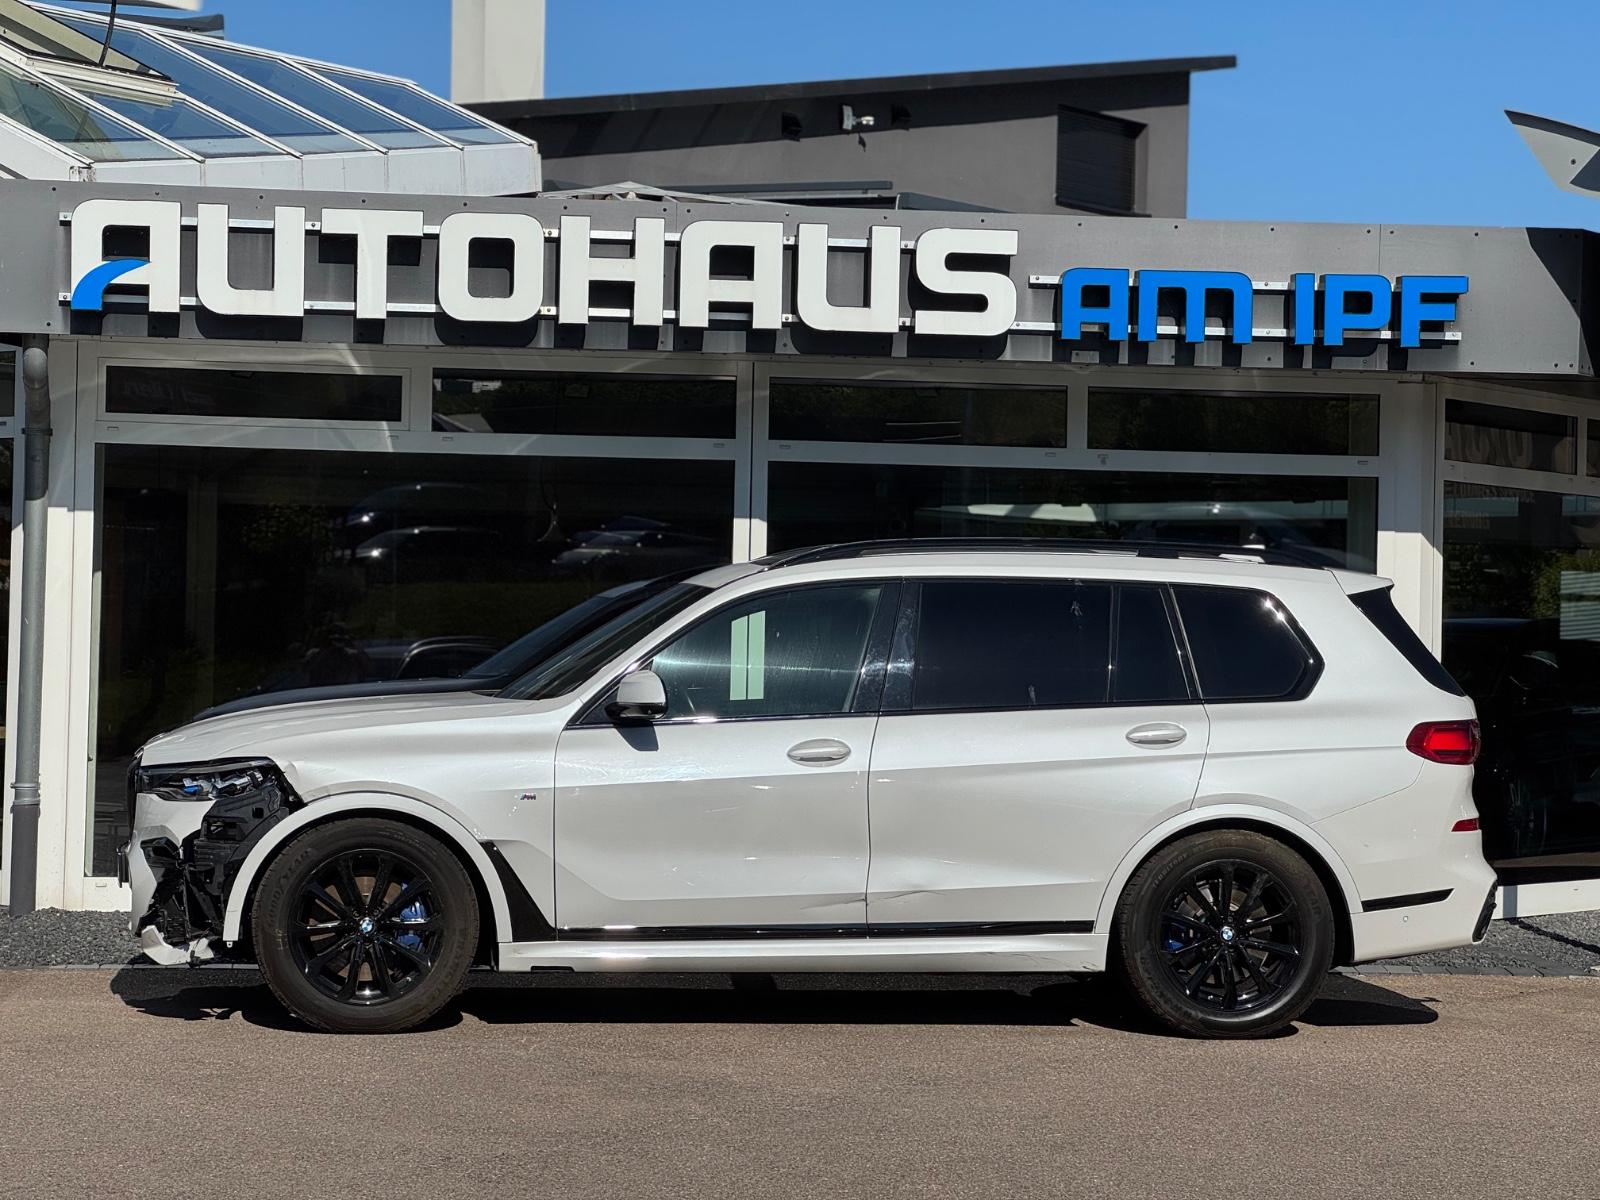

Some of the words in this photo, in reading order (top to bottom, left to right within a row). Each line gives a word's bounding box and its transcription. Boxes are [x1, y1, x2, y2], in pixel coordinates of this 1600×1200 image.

[71, 199, 1018, 336] AUTOHAUS
[1061, 267, 1253, 344] AM
[1291, 273, 1469, 348] IPF
